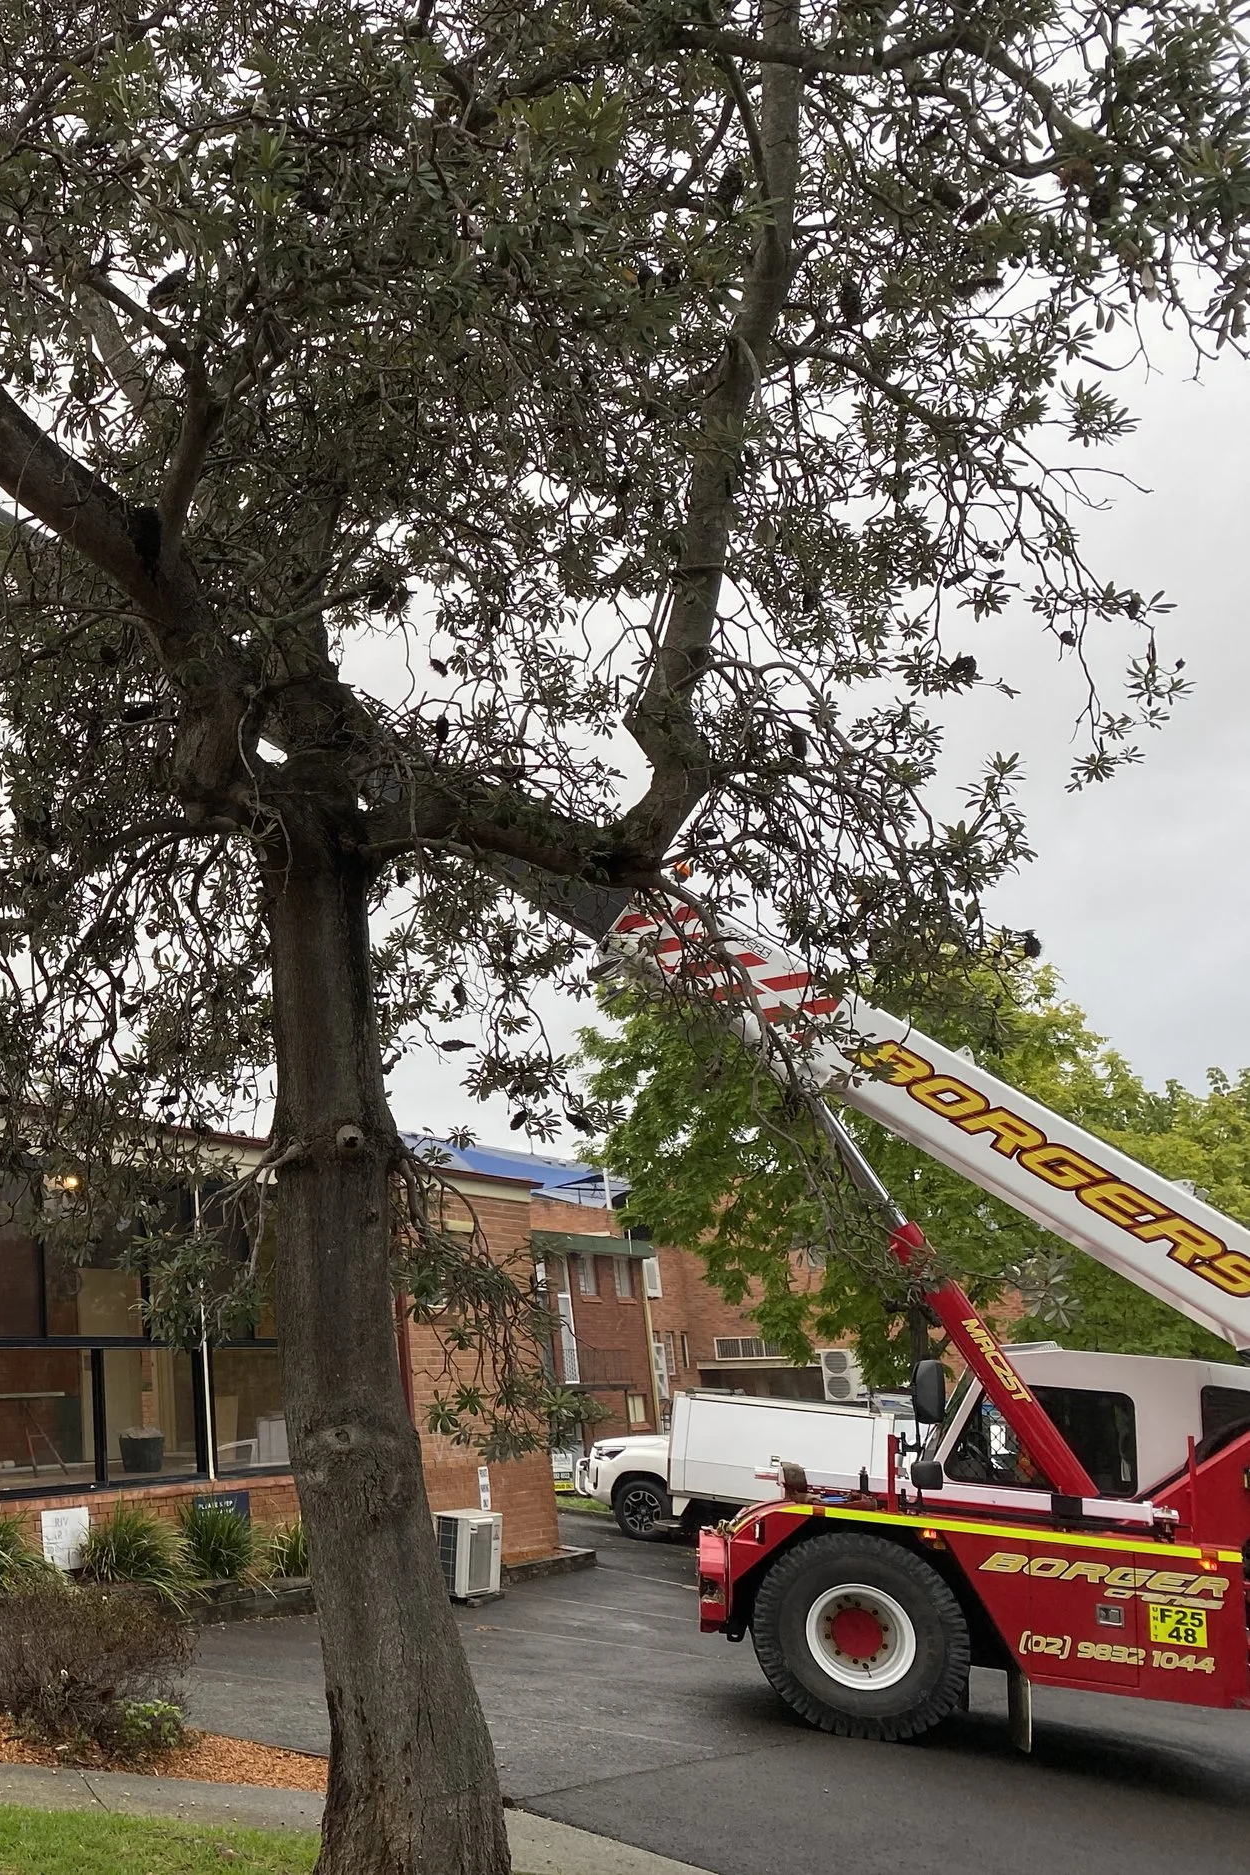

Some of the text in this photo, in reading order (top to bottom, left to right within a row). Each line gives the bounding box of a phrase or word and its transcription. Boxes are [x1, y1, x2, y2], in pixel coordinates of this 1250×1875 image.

[846, 1040, 1250, 1298] BORGERS
[978, 1552, 1230, 1598] BORGER
[1103, 1588, 1225, 1610] cranes
[1159, 1607, 1204, 1628] F25
[1167, 1626, 1198, 1644] 48
[1019, 1630, 1216, 1674] (02) 9832 1044
